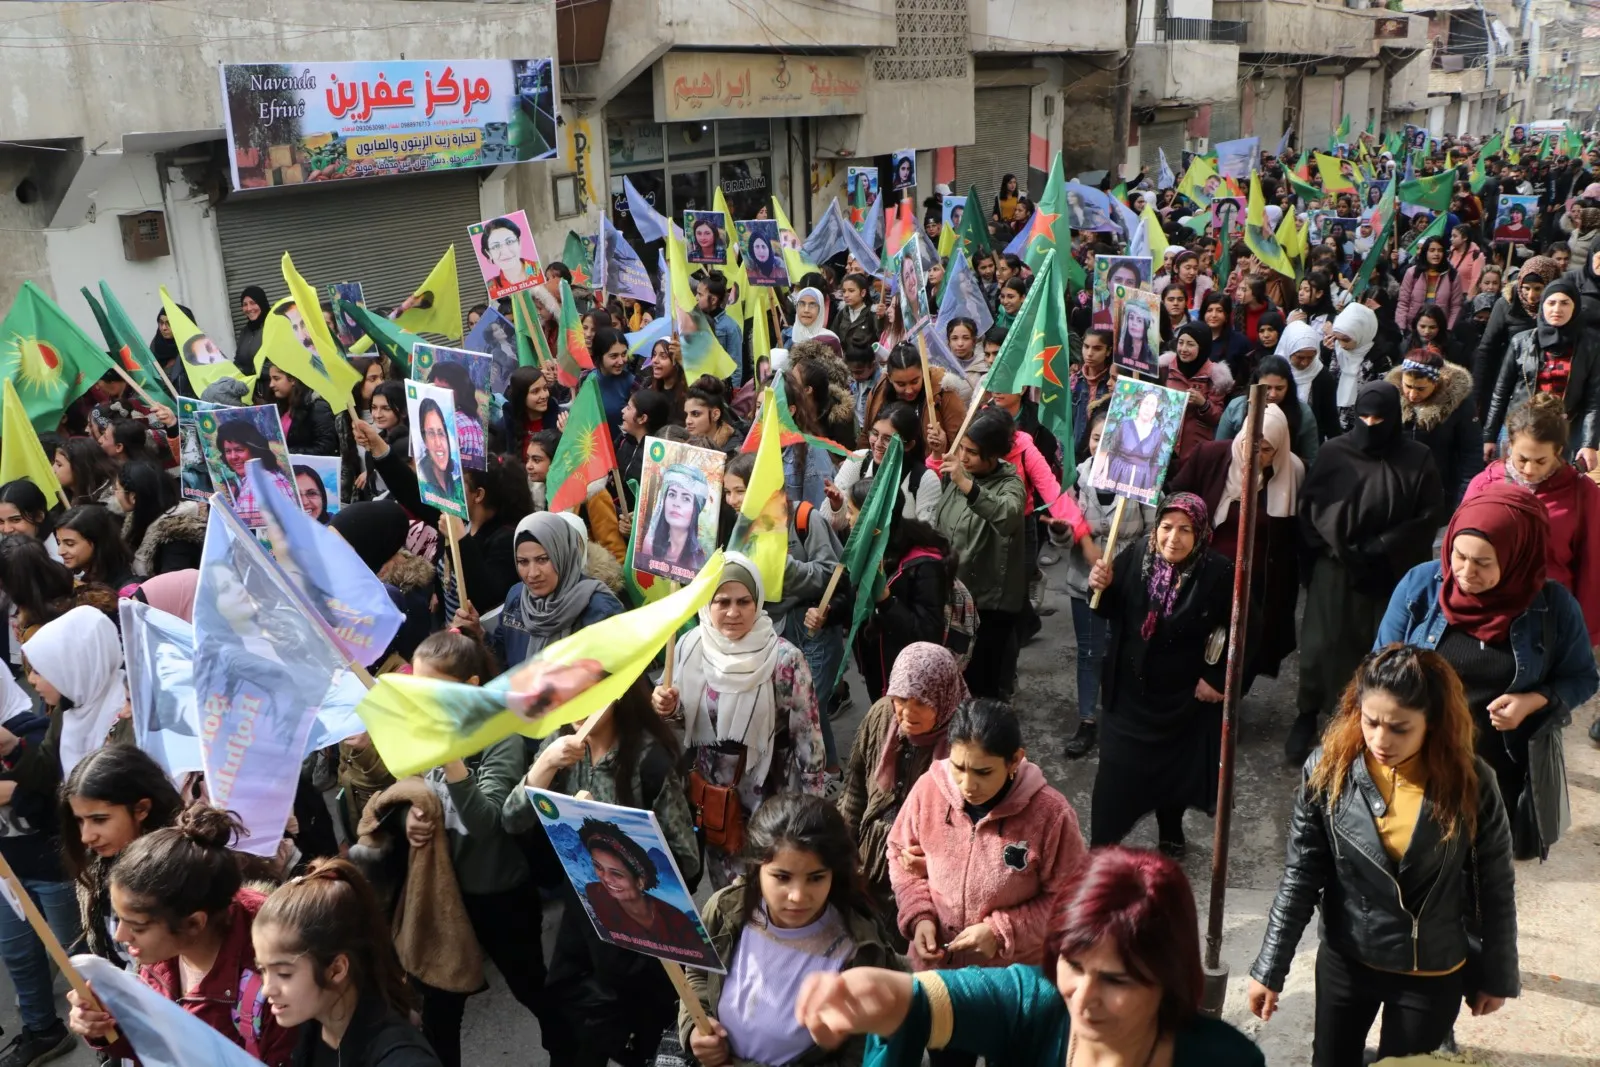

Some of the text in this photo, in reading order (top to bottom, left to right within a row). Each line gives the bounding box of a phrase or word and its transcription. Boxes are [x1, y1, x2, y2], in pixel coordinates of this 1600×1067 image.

[250, 68, 316, 91] Navenda
[325, 66, 491, 121] مركز عفرين
[259, 98, 305, 127] Efrînê
[356, 131, 476, 156] لتجارة زيت الزيتون والصابون
